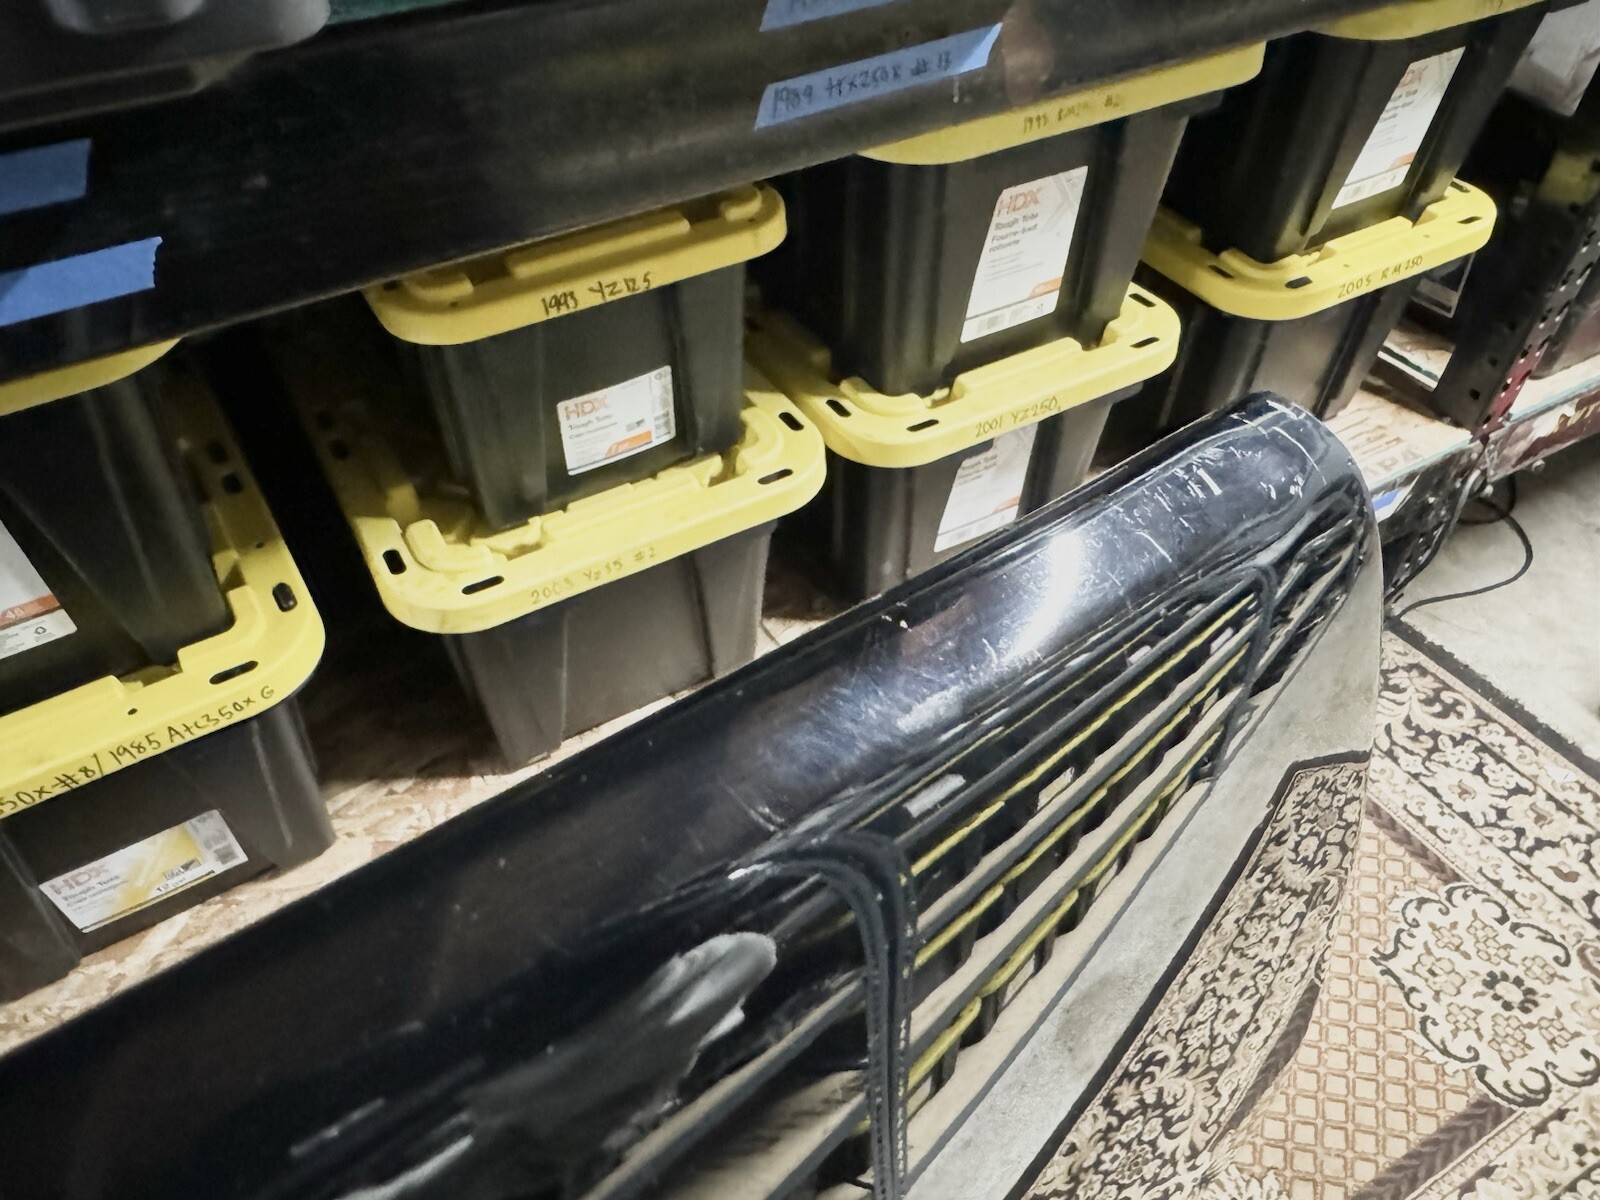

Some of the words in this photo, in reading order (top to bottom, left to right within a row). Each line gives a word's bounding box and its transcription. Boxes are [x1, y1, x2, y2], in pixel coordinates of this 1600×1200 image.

[541, 290, 579, 317] 1993
[975, 414, 1004, 438] 2001
[108, 731, 162, 766] 1985
